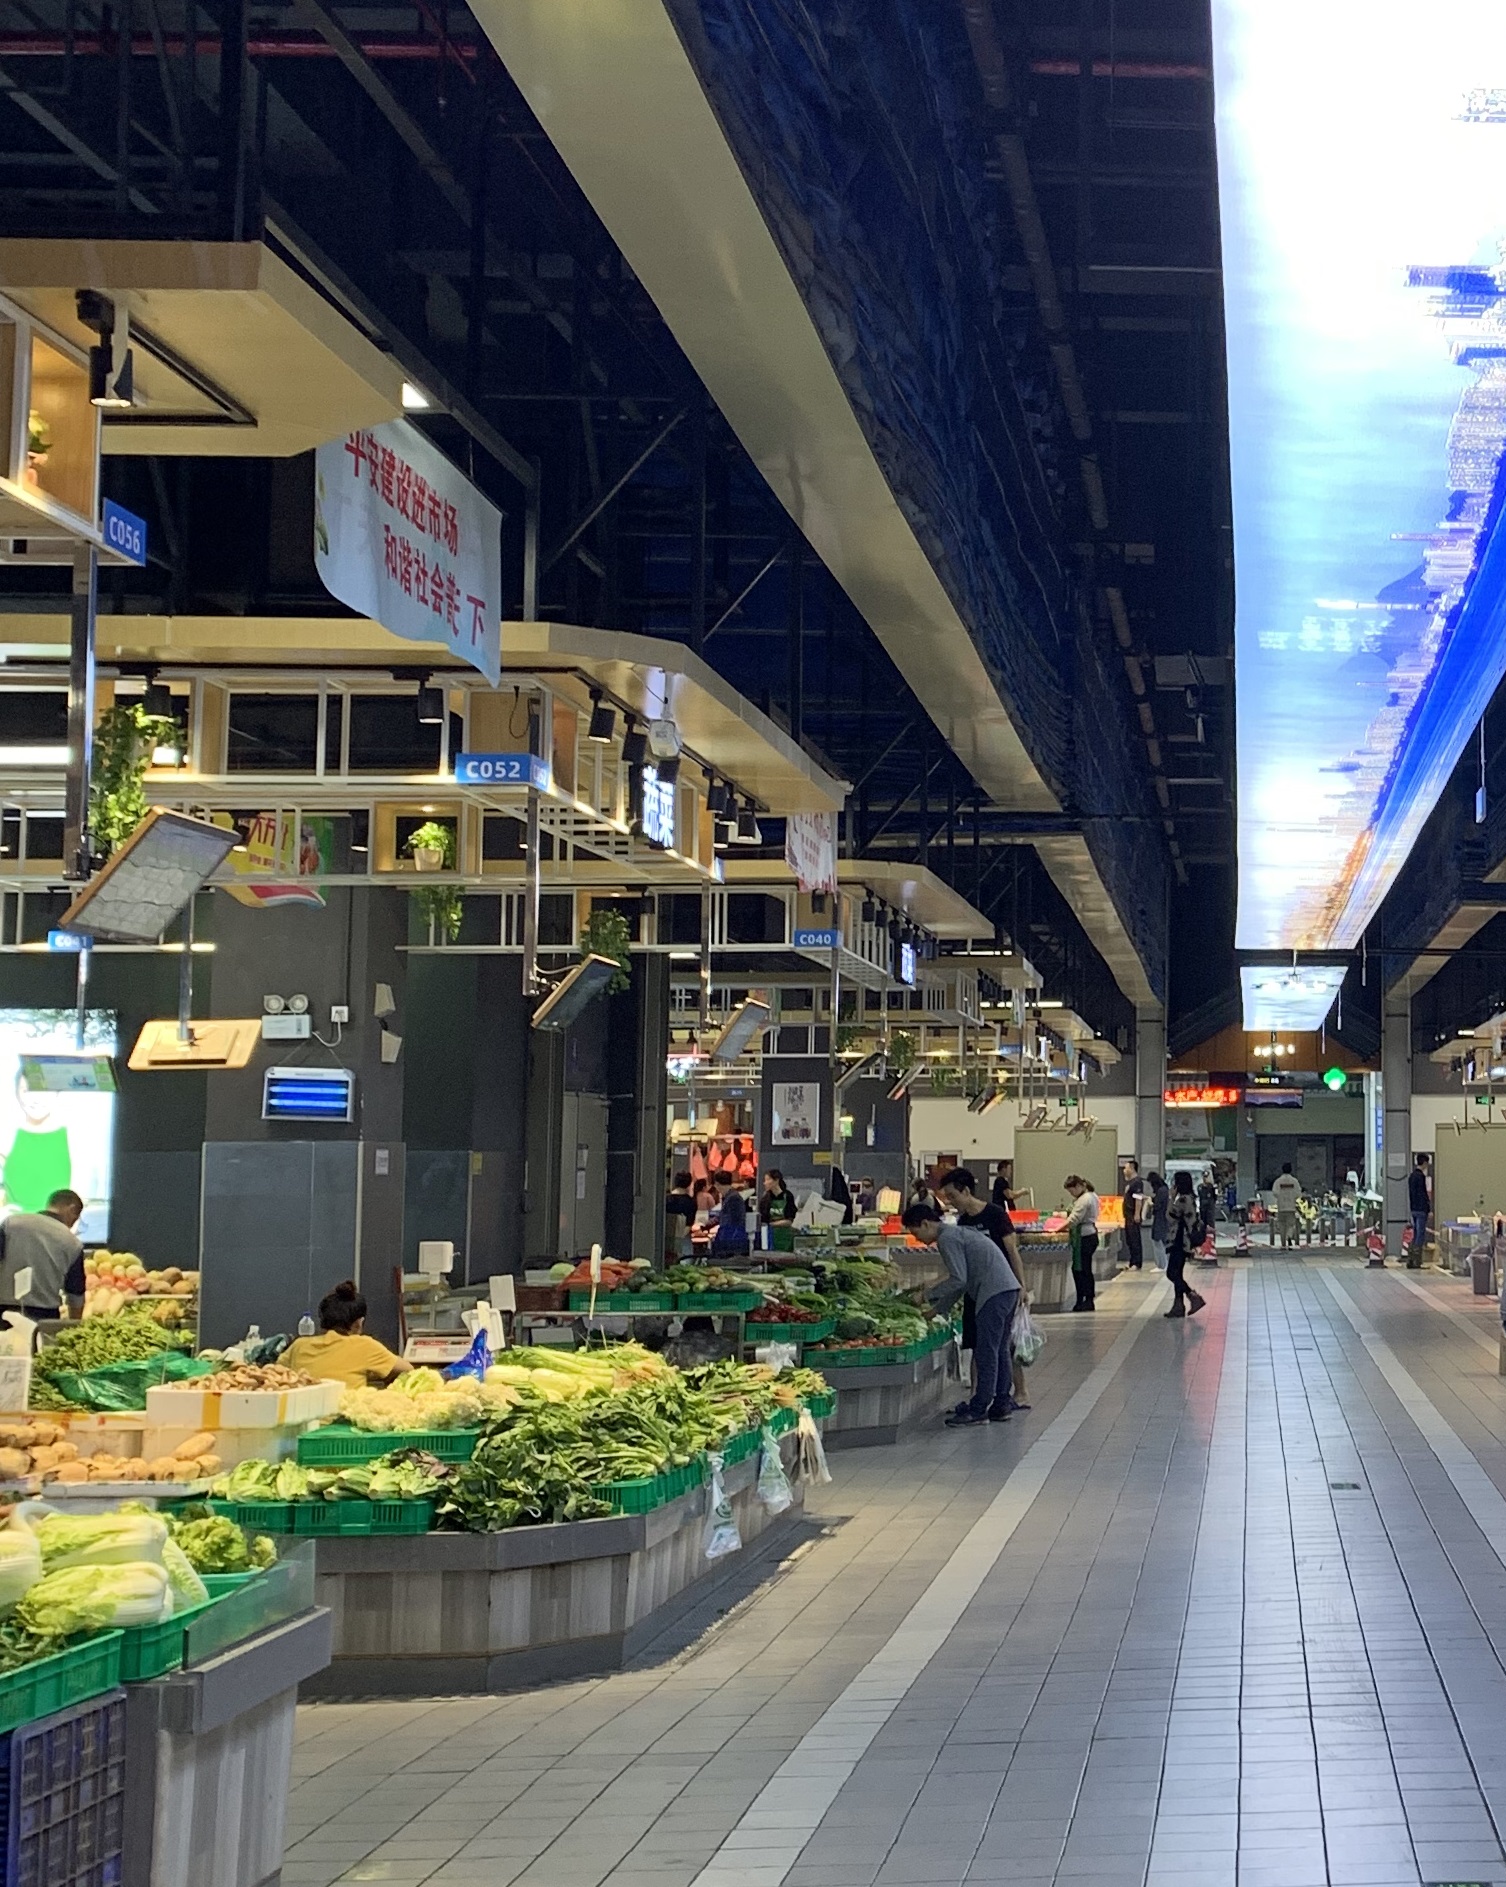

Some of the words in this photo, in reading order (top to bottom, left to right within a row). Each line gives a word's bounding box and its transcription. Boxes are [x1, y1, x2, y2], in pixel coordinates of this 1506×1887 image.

[109, 515, 141, 554] C056
[466, 761, 520, 779] C052
[799, 933, 832, 945] C040
